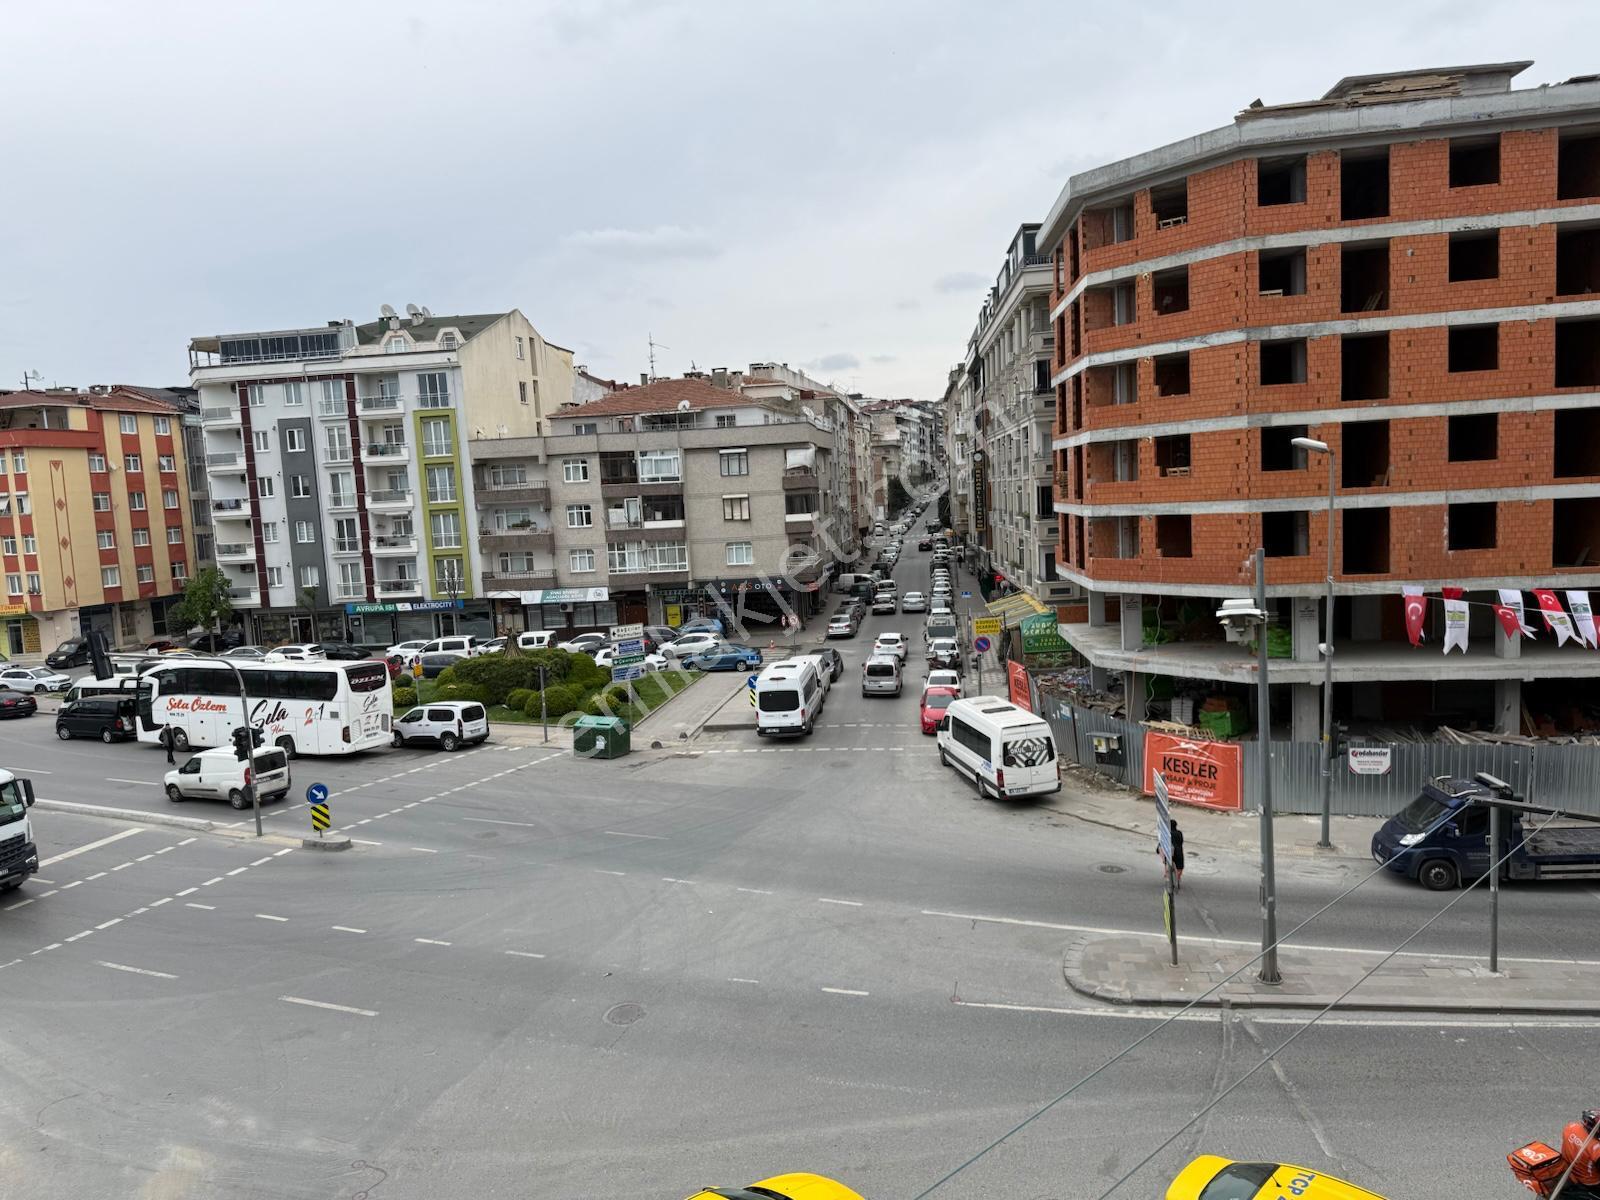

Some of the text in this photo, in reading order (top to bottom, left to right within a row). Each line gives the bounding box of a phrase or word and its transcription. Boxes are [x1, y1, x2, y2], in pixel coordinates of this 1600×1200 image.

[355, 604, 385, 612] AVRUPA
[412, 601, 453, 610] ELEKTROCITY
[191, 696, 227, 712] Özlem
[1163, 756, 1218, 780] KESLER
[1165, 774, 1185, 785] NŞAAT
[1194, 779, 1217, 790] PROJE
[1287, 1172, 1316, 1196] TCP
